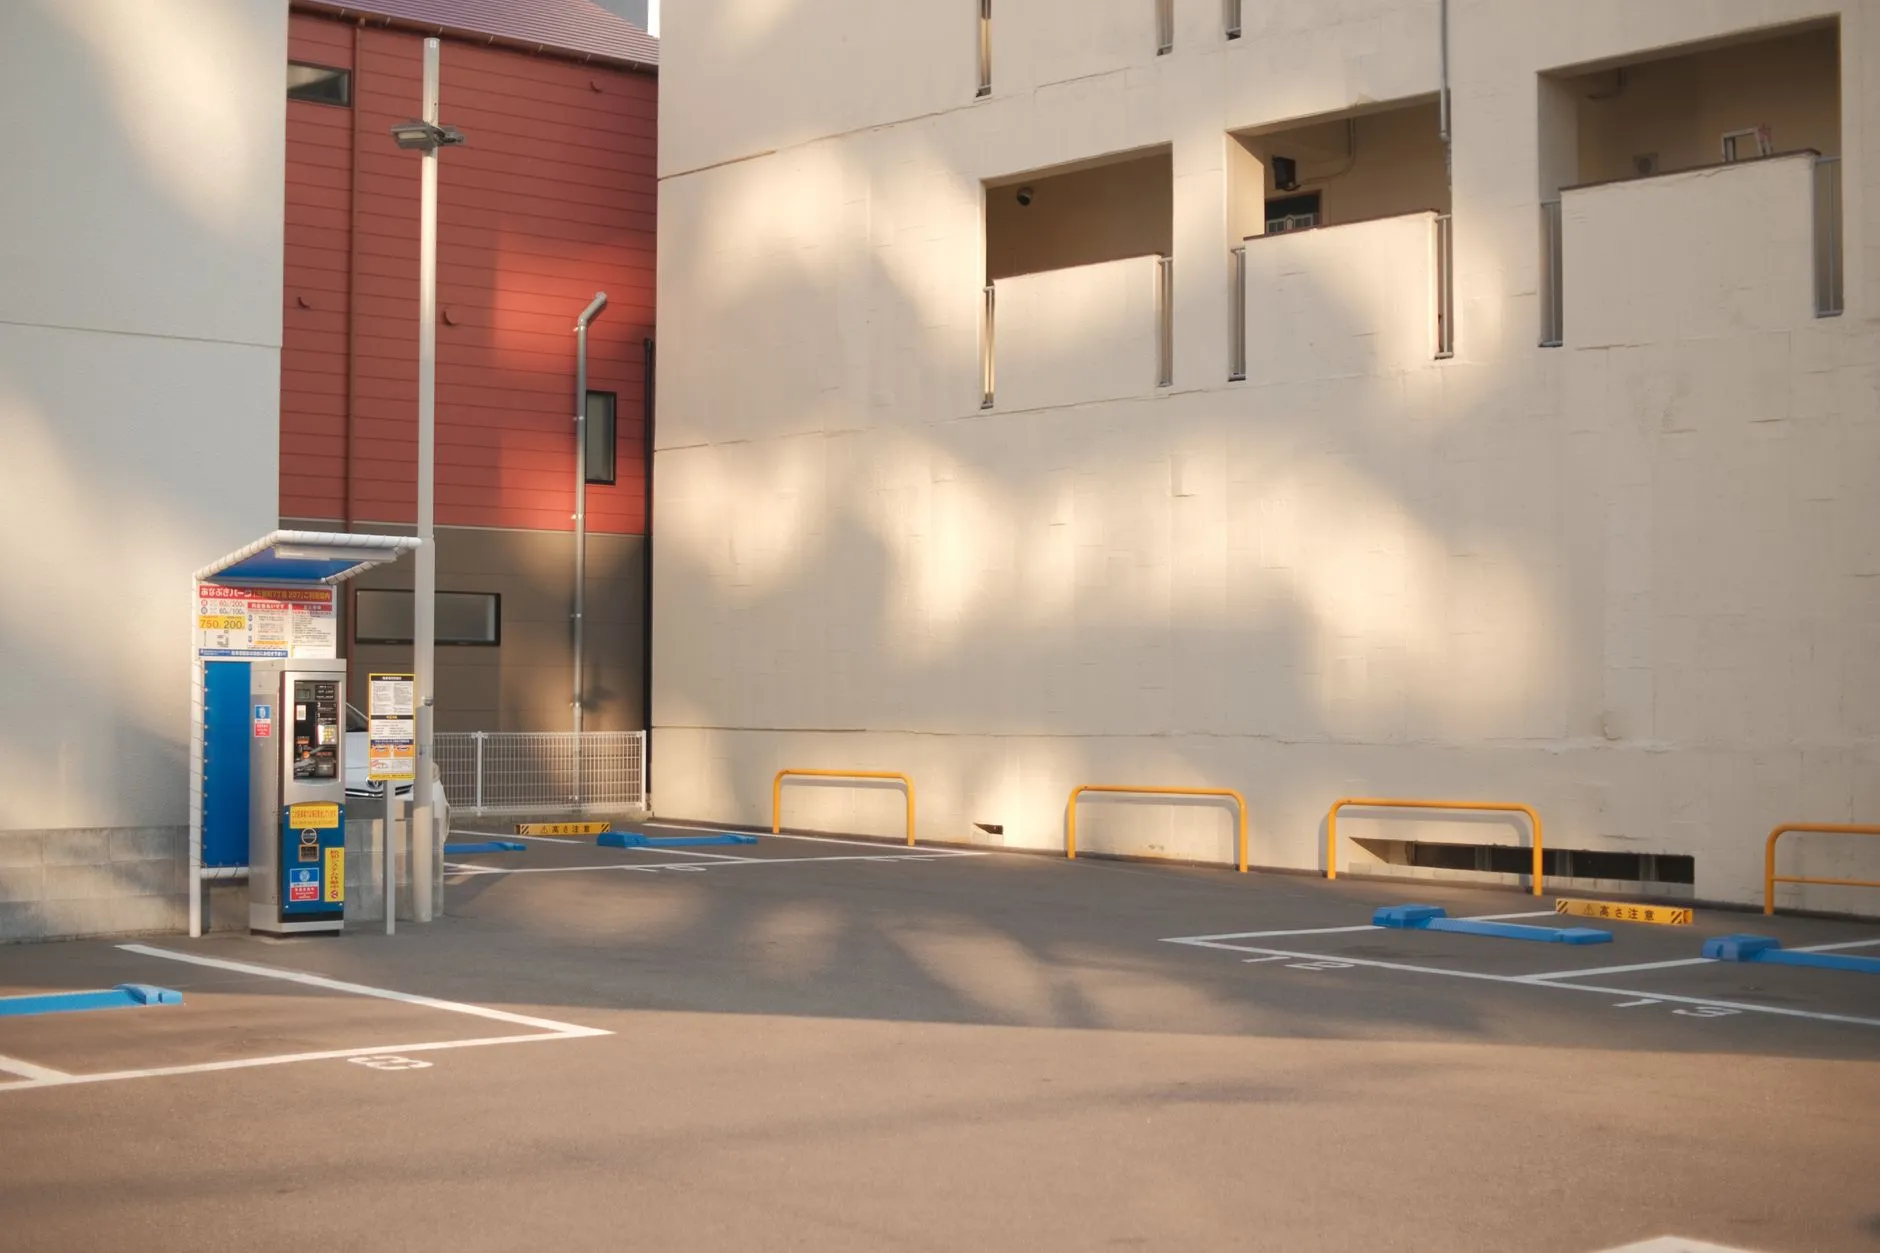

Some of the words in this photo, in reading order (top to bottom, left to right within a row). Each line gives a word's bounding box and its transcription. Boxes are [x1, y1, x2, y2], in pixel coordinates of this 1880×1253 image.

[552, 825, 590, 834] 高さ注意
[1600, 905, 1655, 921] 高さ注意
[1241, 956, 1354, 971] 12
[1612, 998, 1742, 1018] 13
